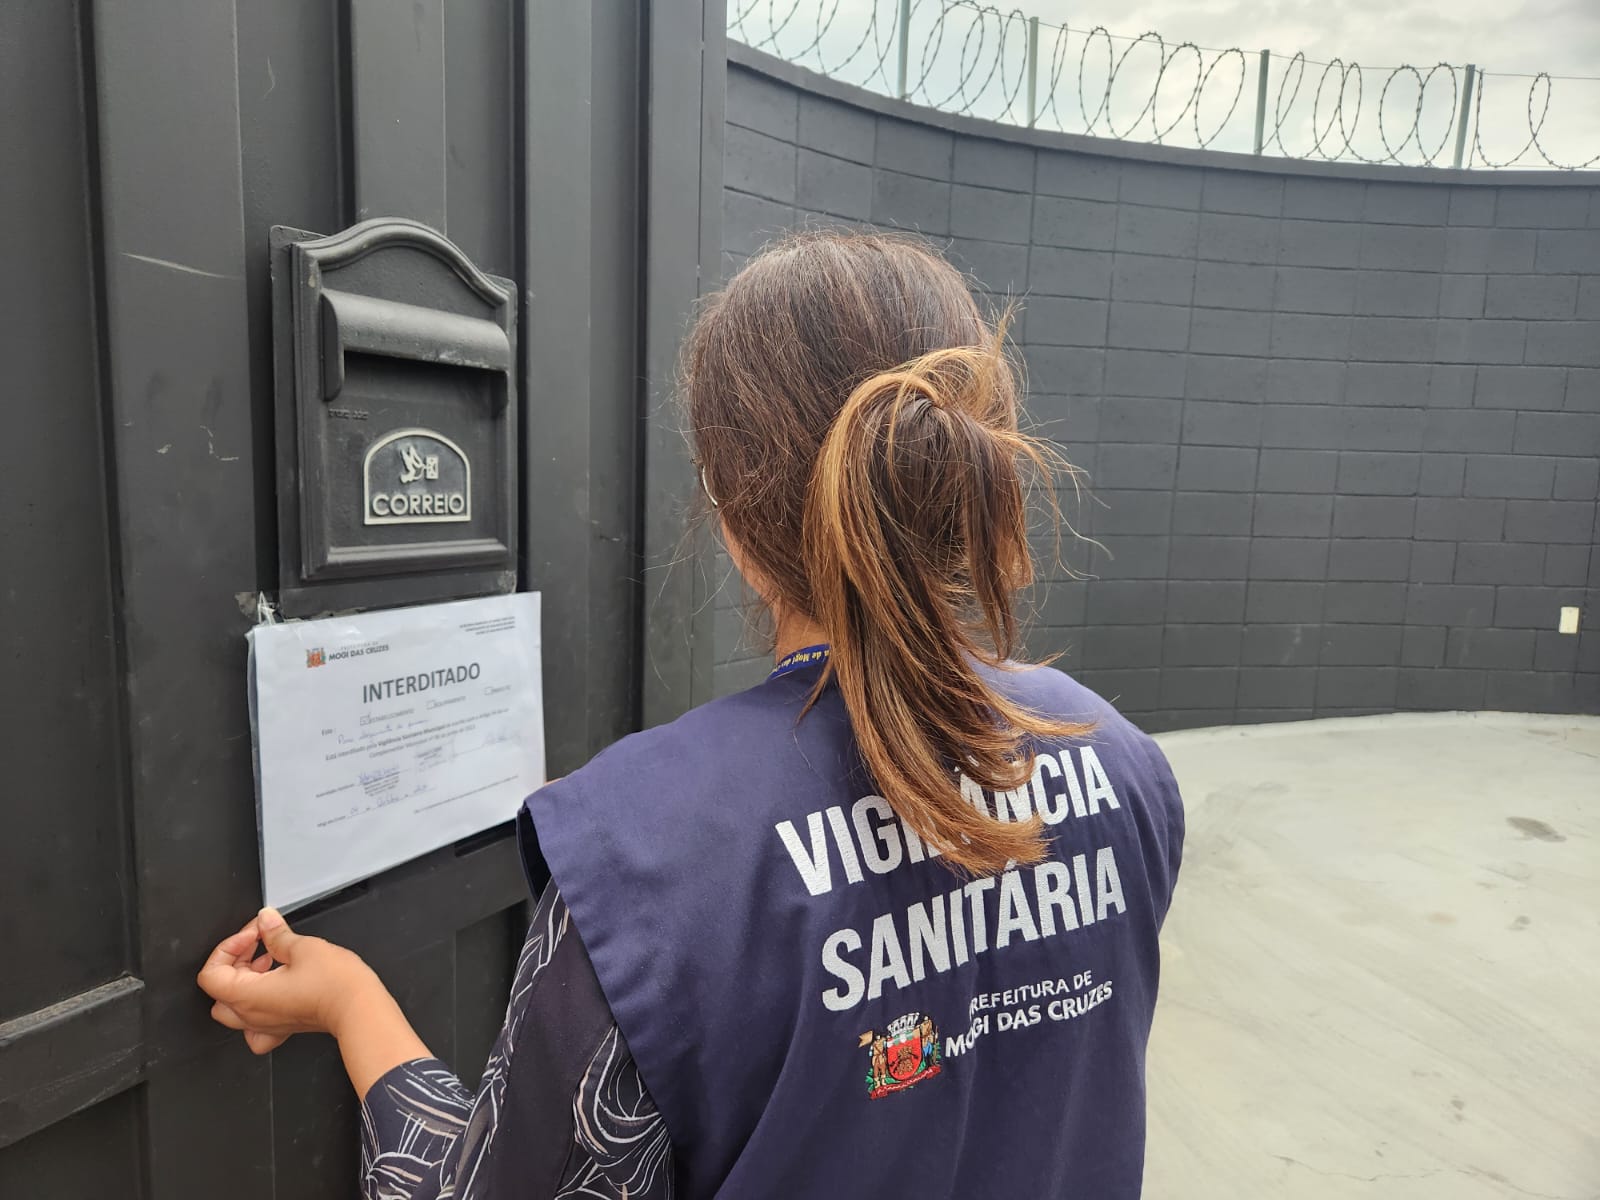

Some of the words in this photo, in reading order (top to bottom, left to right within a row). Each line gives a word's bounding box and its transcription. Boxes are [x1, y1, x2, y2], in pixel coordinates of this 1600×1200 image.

[372, 494, 464, 516] CORREIO
[363, 662, 481, 703] INTERDITADO
[775, 745, 1120, 896] VIGIÂNCIA
[821, 846, 1126, 1012] SANITÁRIA
[968, 979, 1070, 1014] REFEITURA
[1073, 970, 1093, 991] DE
[997, 1005, 1042, 1032] DAS
[1048, 980, 1113, 1021] CRUZES
